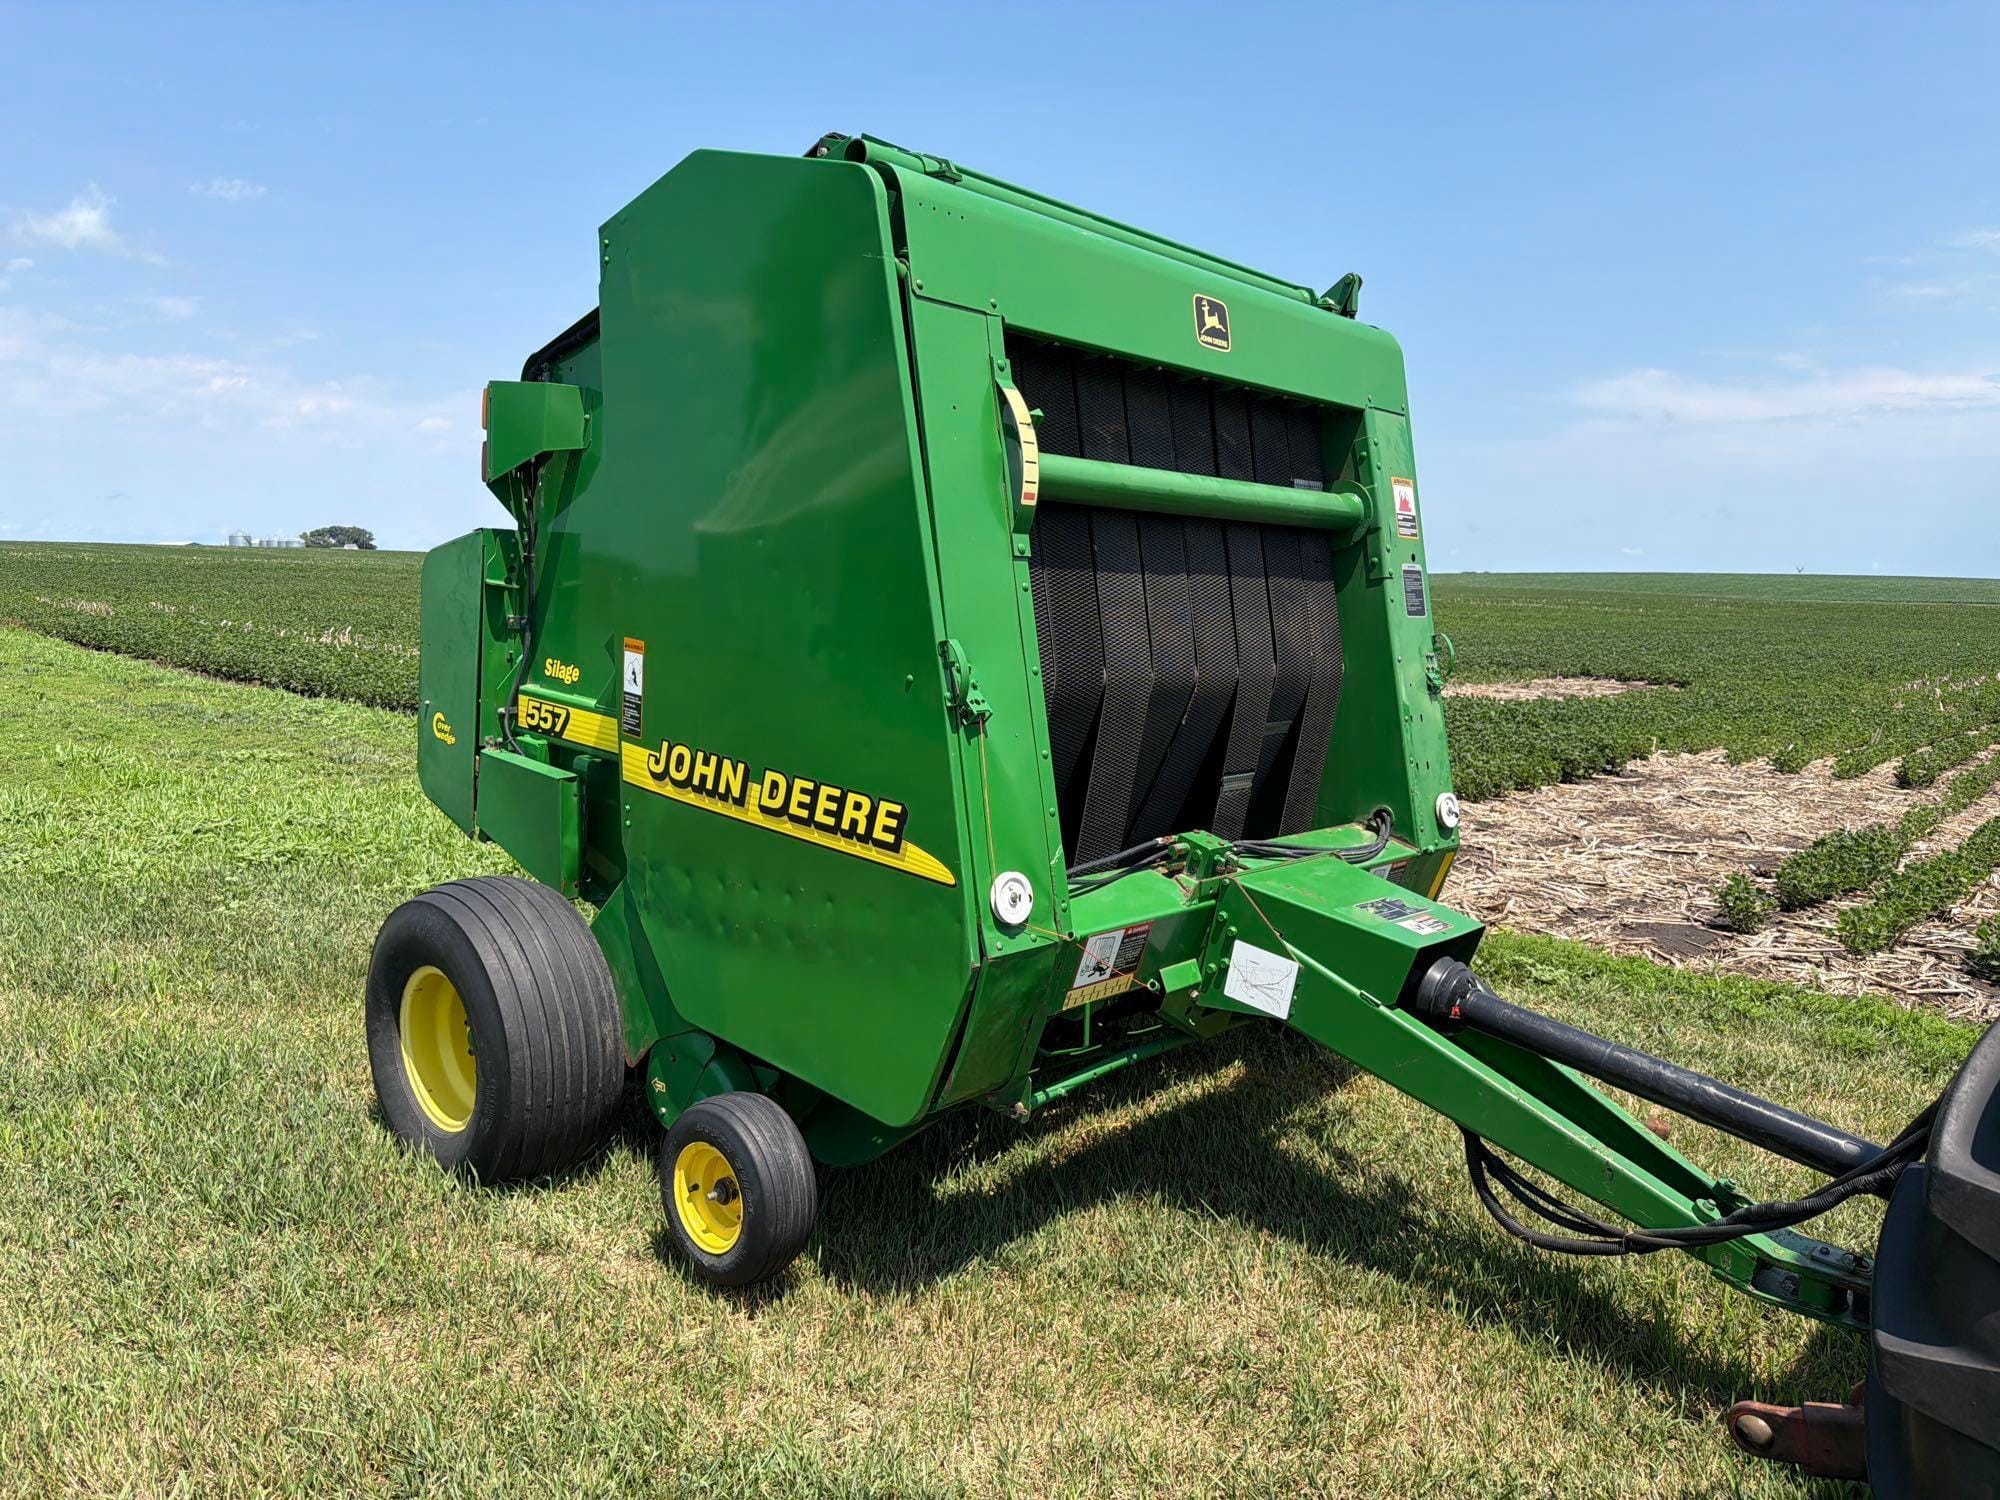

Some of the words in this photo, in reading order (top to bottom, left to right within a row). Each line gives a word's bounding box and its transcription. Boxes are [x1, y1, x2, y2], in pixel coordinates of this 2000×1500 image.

[544, 658, 580, 685] Silage
[527, 700, 569, 735] 557
[648, 740, 748, 803] JOHN
[759, 769, 905, 849] DEERE
